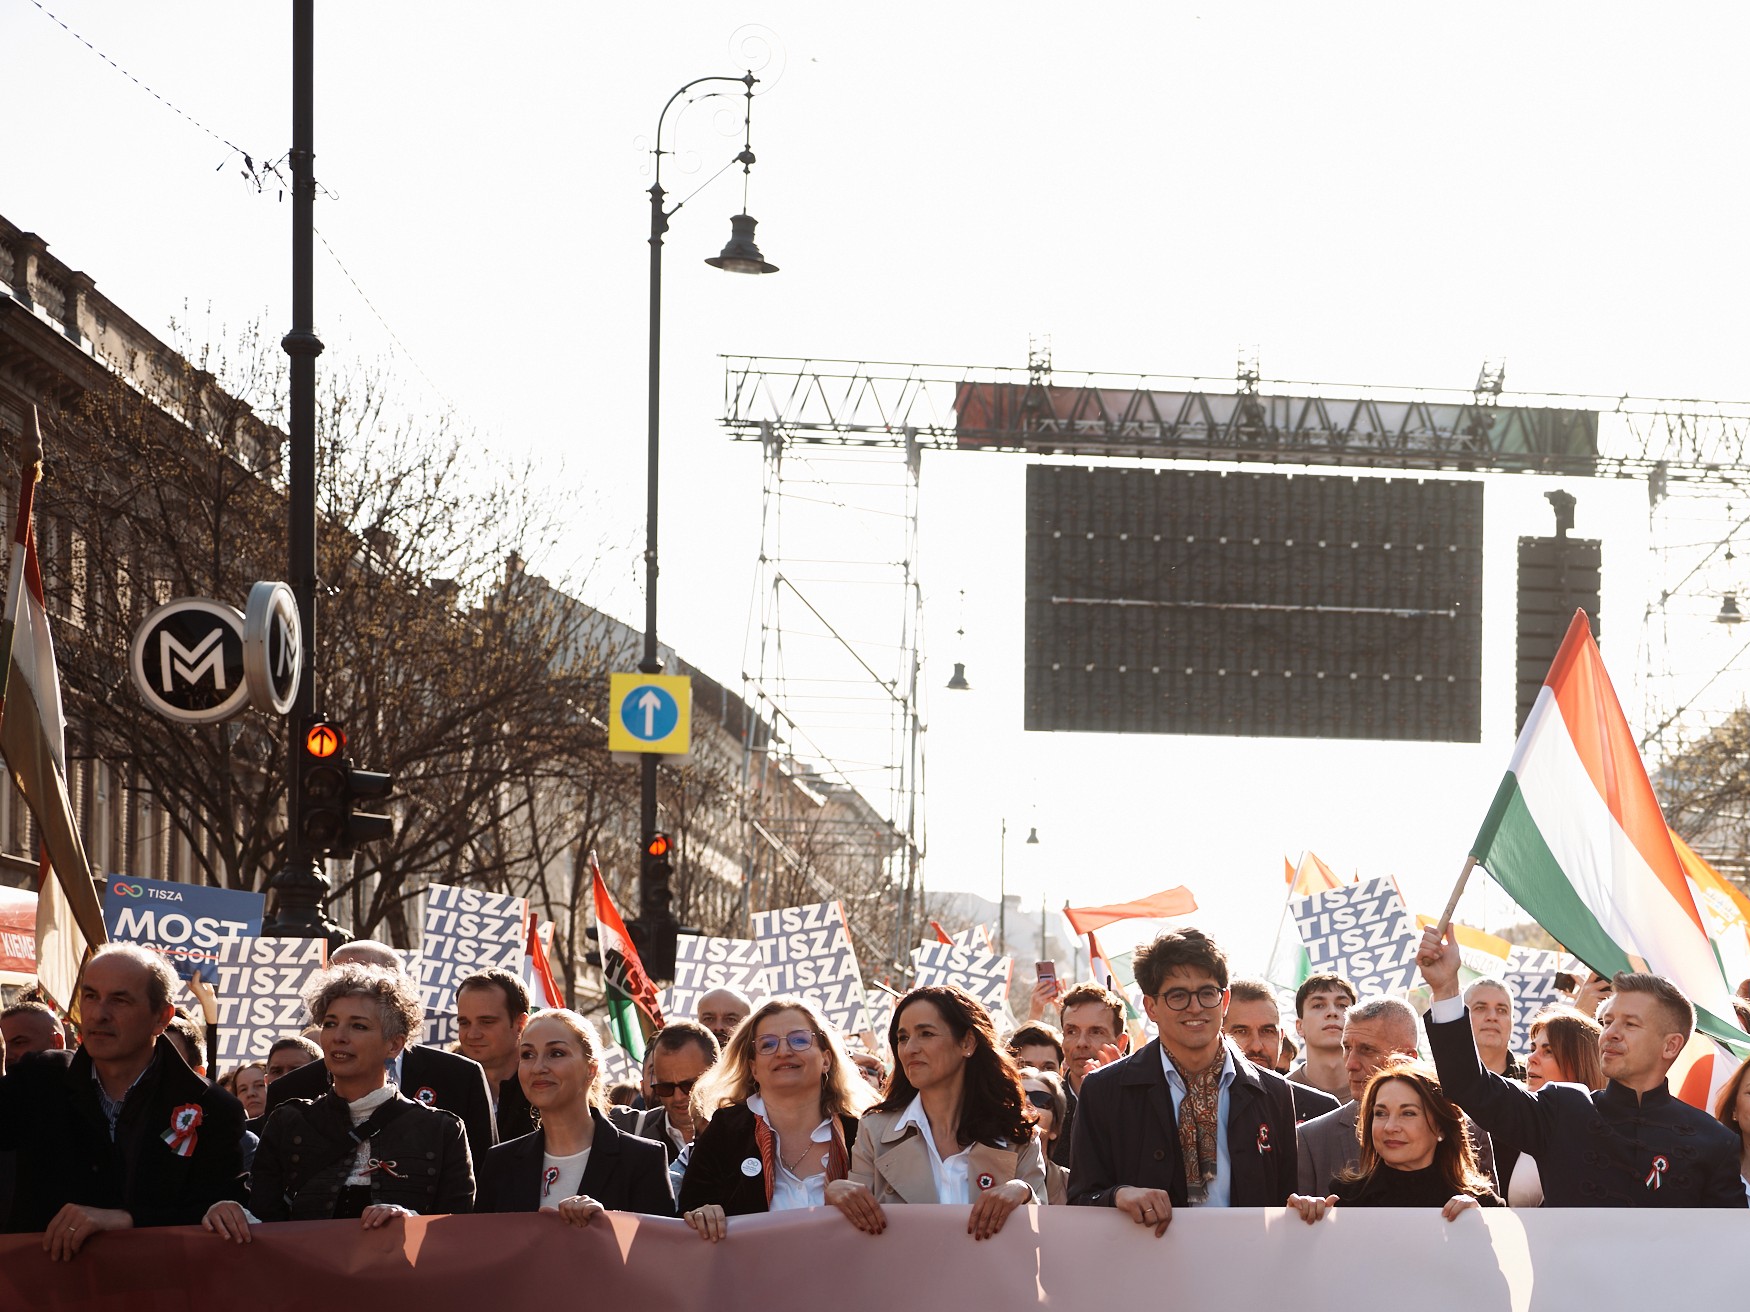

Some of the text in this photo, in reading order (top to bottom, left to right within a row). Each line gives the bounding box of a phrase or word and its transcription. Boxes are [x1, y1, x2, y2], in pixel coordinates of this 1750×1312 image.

[160, 628, 226, 692] M
[148, 888, 183, 902] TISZA
[429, 883, 525, 920] TISZA
[1288, 874, 1398, 918] TISZA
[114, 907, 248, 948] MOST
[426, 908, 523, 945] TISZA
[750, 900, 844, 937] TISZA
[1296, 895, 1407, 940] TISZA
[174, 946, 219, 965] SOH
[218, 936, 323, 965] TISZA
[423, 933, 523, 974] TISZA
[757, 927, 851, 964] TISZA
[1303, 915, 1416, 962] TISZA
[421, 959, 476, 989] TIS
[764, 955, 859, 992] TISZA
[918, 939, 1012, 980] TISZA
[1505, 951, 1559, 973] SZA
[674, 961, 771, 997] TISZA
[913, 965, 1007, 1005] TISZA
[1354, 967, 1429, 1000] SZA
[1503, 974, 1559, 999] SZA
[217, 997, 307, 1026] TISZ
[216, 1028, 301, 1057] TIS
